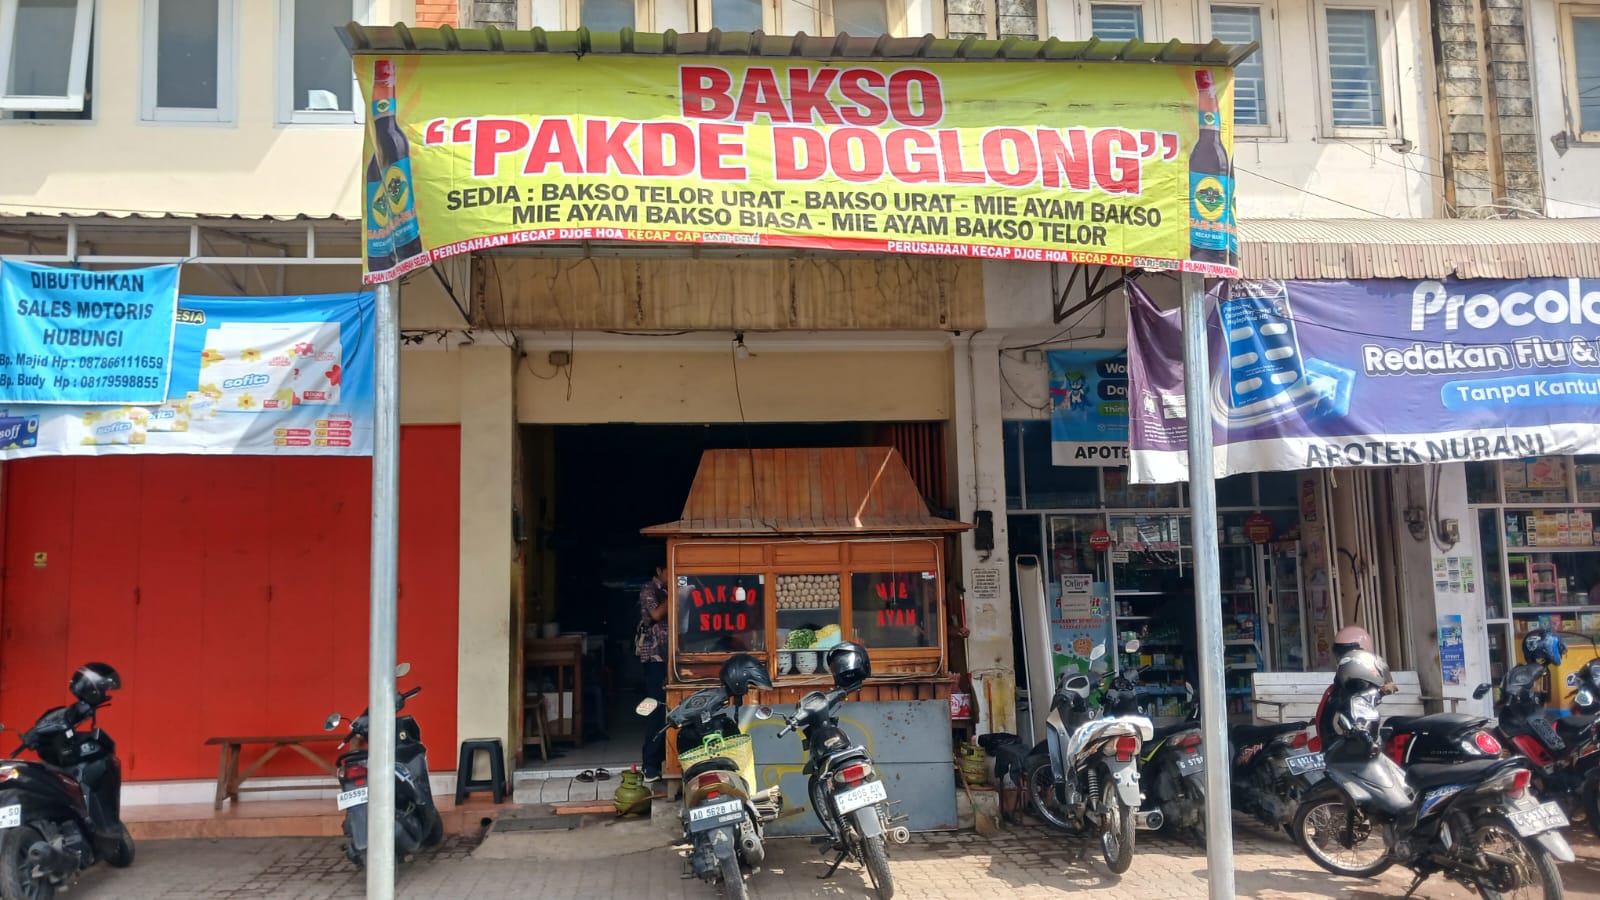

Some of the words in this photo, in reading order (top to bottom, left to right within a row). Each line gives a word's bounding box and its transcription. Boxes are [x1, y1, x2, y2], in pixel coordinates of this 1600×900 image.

[681, 67, 944, 127] BAKSO
[446, 185, 521, 211] SEDIA
[541, 183, 629, 202] BAKSO
[635, 185, 714, 205] TELOR
[721, 190, 785, 209] URAT
[805, 191, 887, 211] BAKSO
[894, 192, 955, 213] URAT
[974, 194, 1018, 216] MIE
[1023, 197, 1084, 221] AYAM
[1090, 202, 1162, 228] BAKSO
[513, 204, 560, 224] MIE
[567, 203, 638, 223] AYAM
[646, 206, 732, 226] BAKSO
[739, 209, 813, 230] BIASA
[832, 212, 878, 233] MIE
[883, 213, 948, 236] AYAM
[955, 216, 1033, 241] BAKSO
[1038, 220, 1107, 246] TELOR
[433, 235, 508, 260] PERUSAHAAN
[512, 229, 556, 243] KECAP
[559, 228, 592, 240] DJOE
[595, 228, 623, 240] HOA
[627, 229, 673, 241] KECAP
[675, 231, 700, 241] CAP
[887, 240, 968, 255] PERUSAHAAN
[971, 245, 1011, 258] KECAP
[1014, 248, 1042, 260] DJOE
[1045, 250, 1068, 262] HOA
[1071, 252, 1107, 265] KECAP
[1110, 254, 1132, 266] CAP
[31, 271, 144, 292] DIBUTUHKAN
[17, 300, 72, 318] SALES
[77, 302, 154, 320] MOTORIS
[42, 328, 123, 347] HUBUNGI
[16, 353, 48, 369] Majid
[52, 355, 68, 370] Hp
[79, 355, 164, 369] 087866111659
[1363, 341, 1511, 373] Redakan
[1514, 337, 1567, 365] Flu
[1571, 337, 1597, 362] &
[17, 373, 46, 389] Budy
[53, 375, 70, 390] Hp
[80, 375, 159, 389] 08179598855
[223, 374, 270, 388] sofita
[1457, 382, 1530, 404] Tanpa
[1306, 440, 1424, 467] APOTEK
[1426, 433, 1546, 462] NURANI
[875, 581, 909, 600] MIE
[700, 612, 747, 631] SOLO
[877, 608, 916, 627] AYAM
